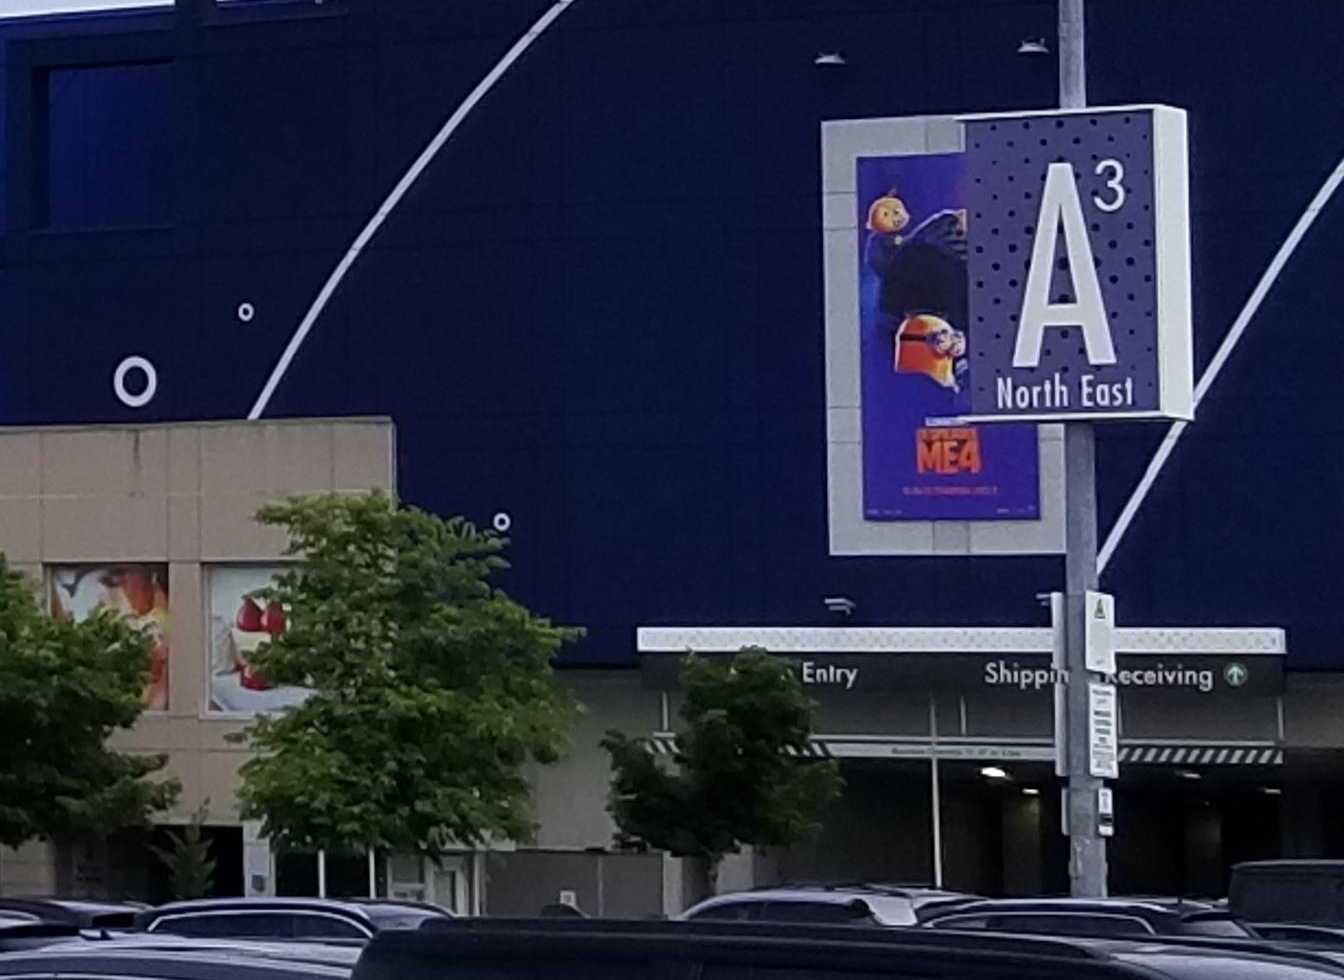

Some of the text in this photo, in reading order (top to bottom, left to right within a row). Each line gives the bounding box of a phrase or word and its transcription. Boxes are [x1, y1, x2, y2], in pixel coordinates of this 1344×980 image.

[997, 373, 1134, 410] North East
[802, 661, 859, 689] Entry
[984, 660, 1069, 690] Shippin
